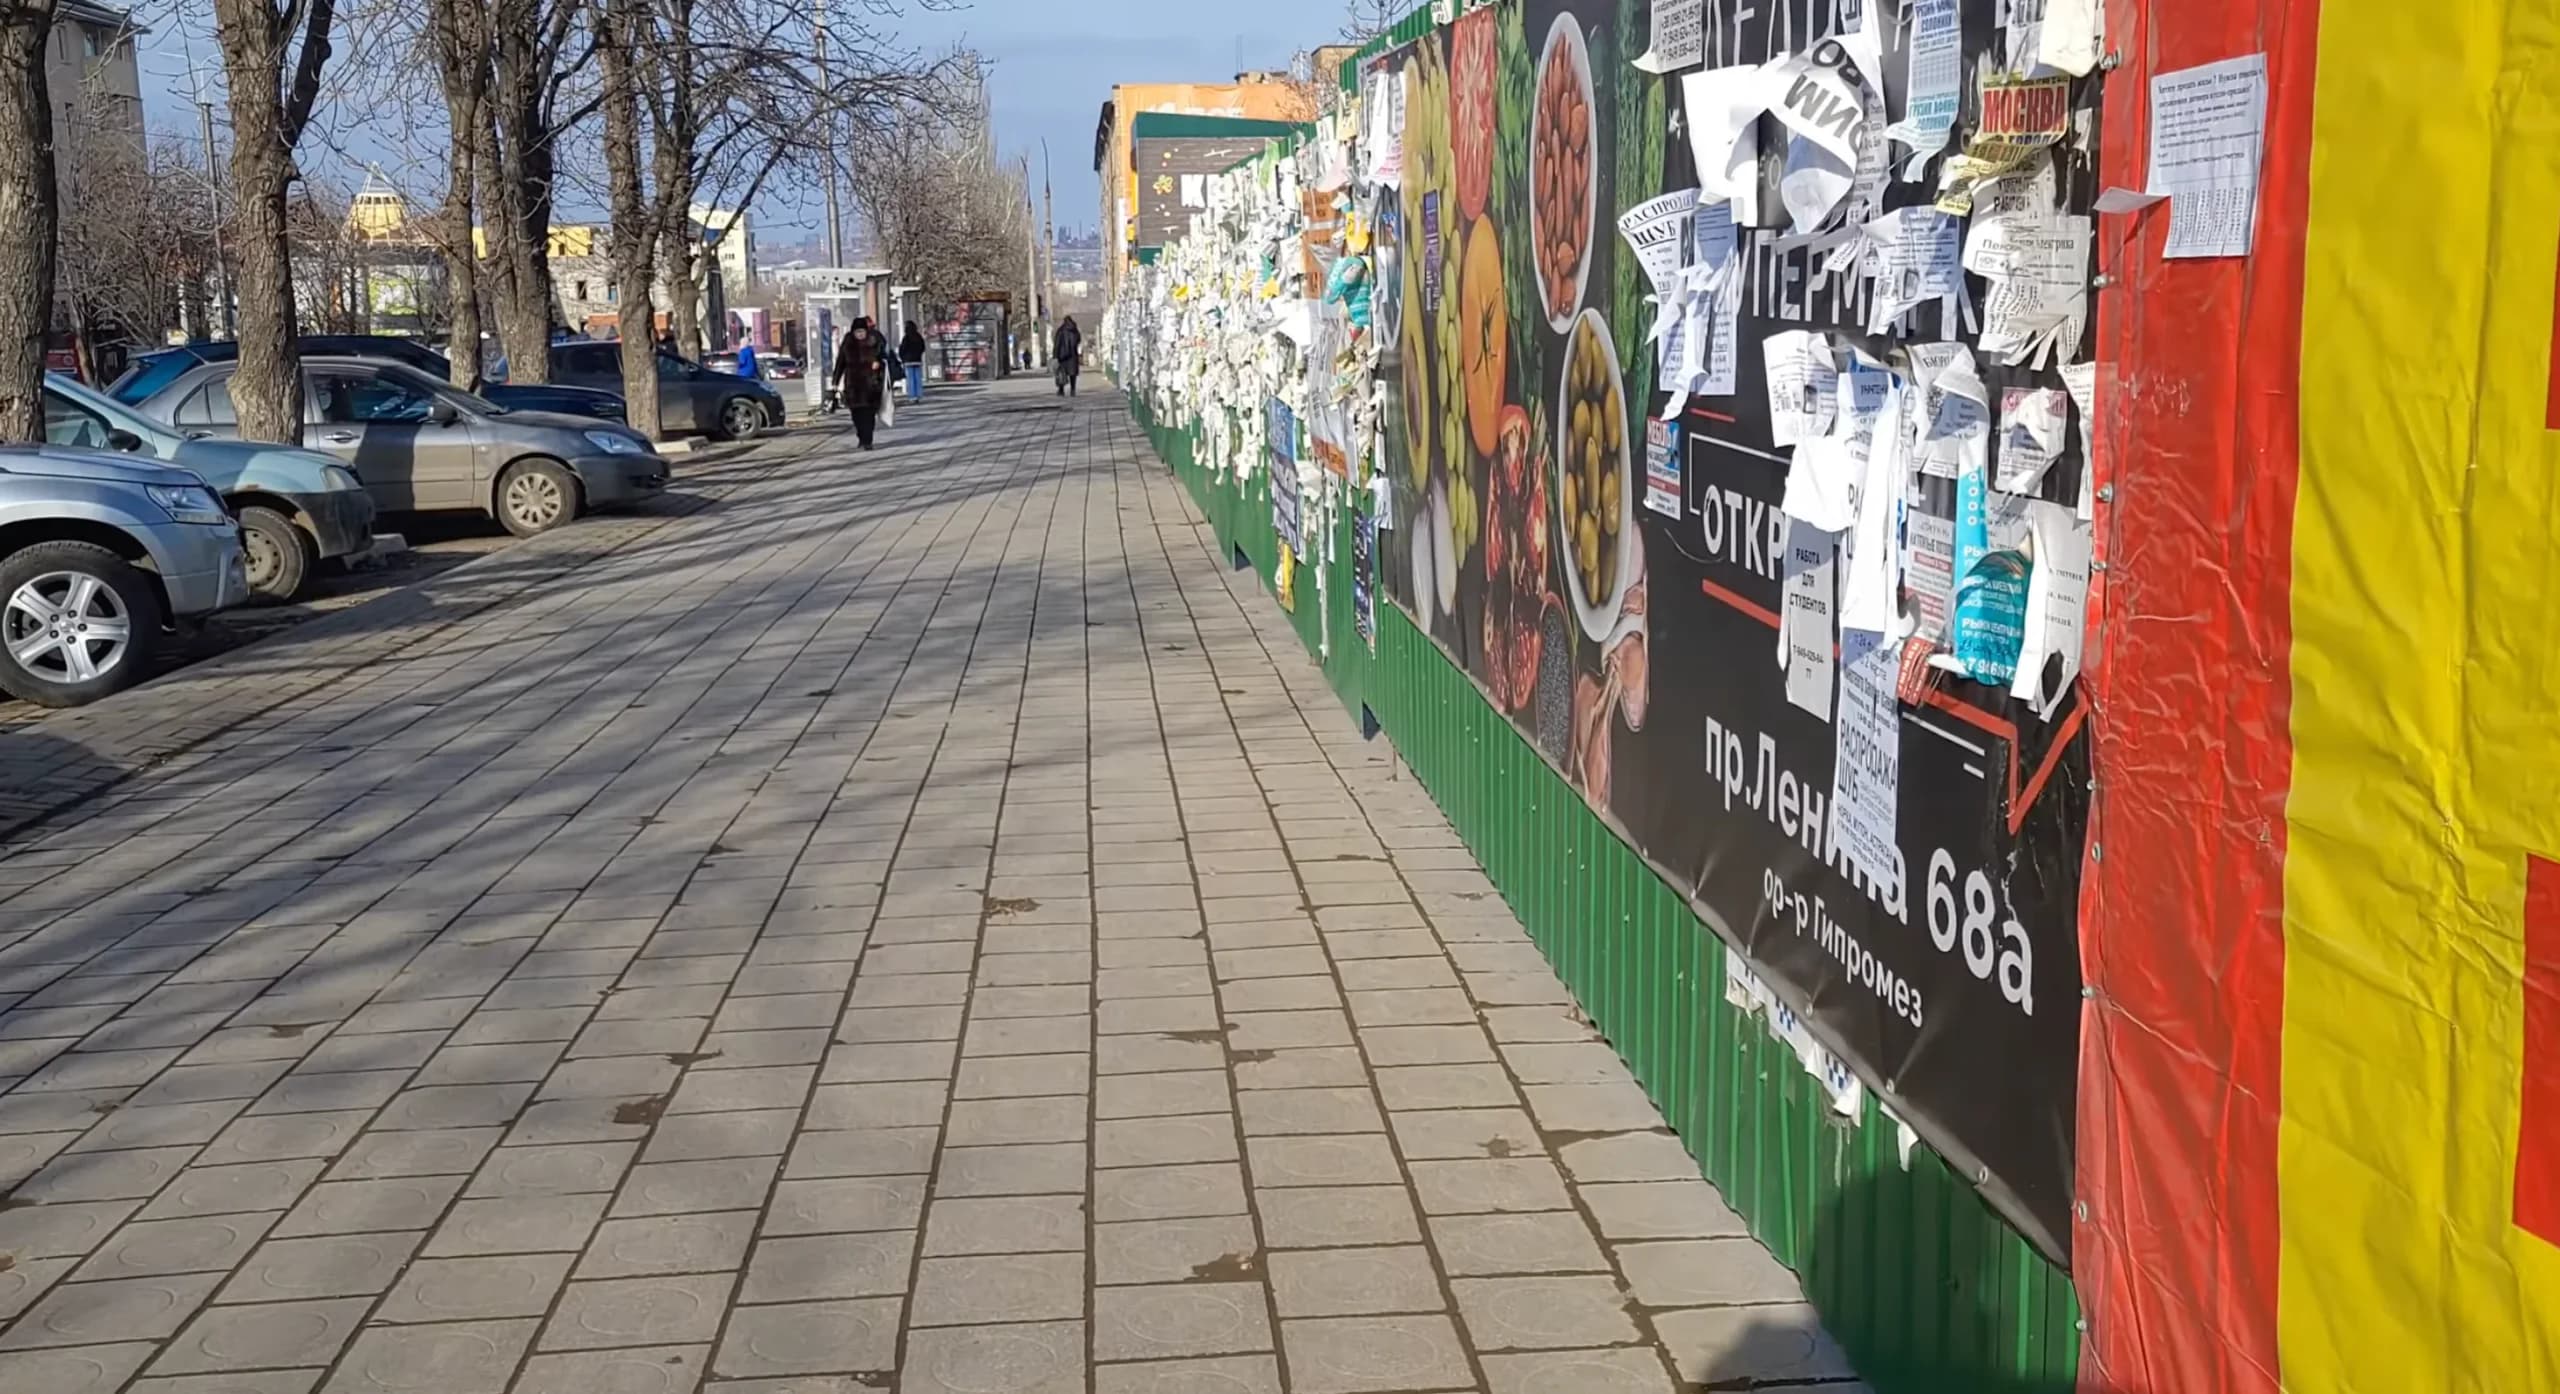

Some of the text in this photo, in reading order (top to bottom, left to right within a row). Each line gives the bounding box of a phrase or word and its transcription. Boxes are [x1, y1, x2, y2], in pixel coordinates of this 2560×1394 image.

[1983, 86, 2066, 133] МОСКВА
[1634, 220, 1677, 246] ШУБ
[1838, 755, 1859, 804] ШУБ
[1840, 718, 1897, 791] РАСПРОДАЖА
[1706, 717, 2033, 1016] пр.Лениа 68а
[1764, 867, 1924, 1029] ор-р Гипромез
